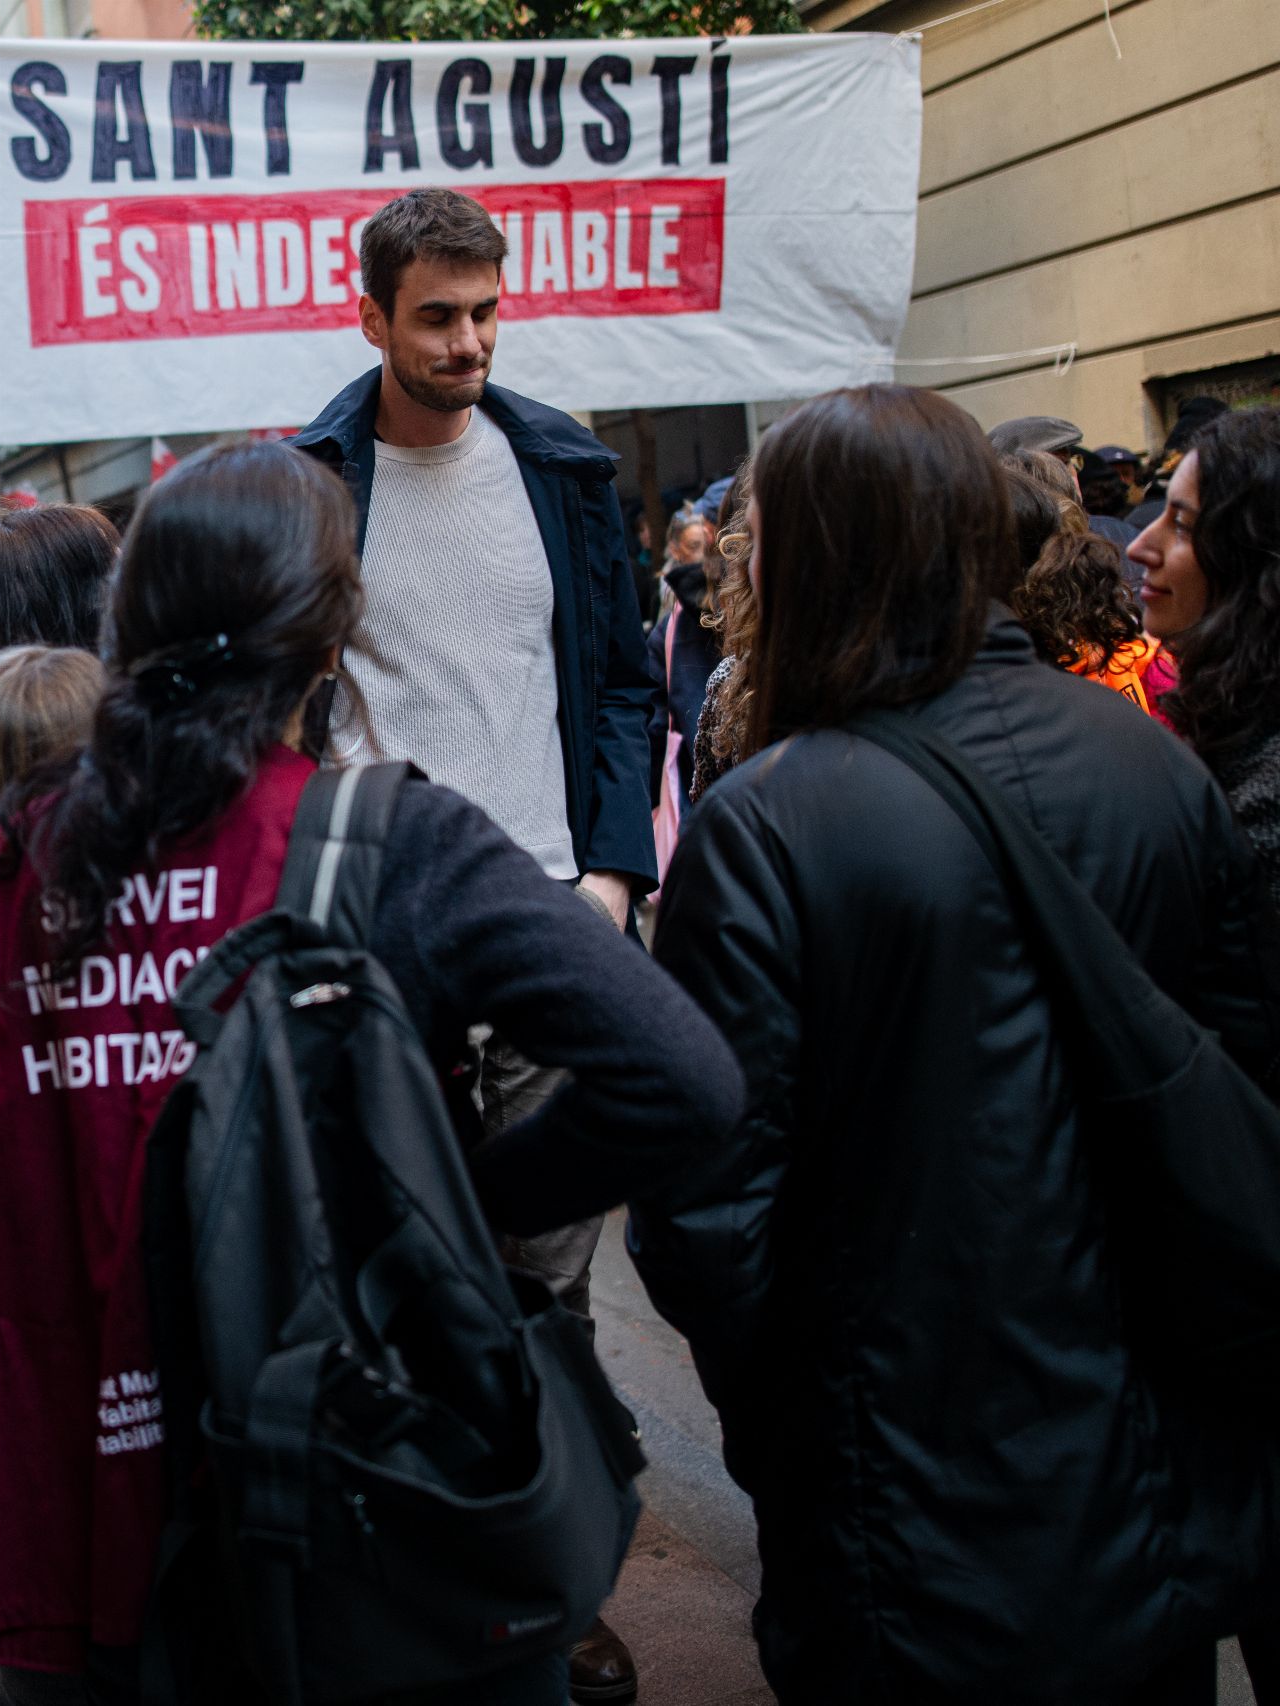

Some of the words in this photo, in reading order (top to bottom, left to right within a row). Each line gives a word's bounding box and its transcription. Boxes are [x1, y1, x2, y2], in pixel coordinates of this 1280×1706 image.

[10, 59, 305, 183] SANT
[362, 37, 732, 174] AGUSTÍ
[77, 202, 162, 319] ÉS
